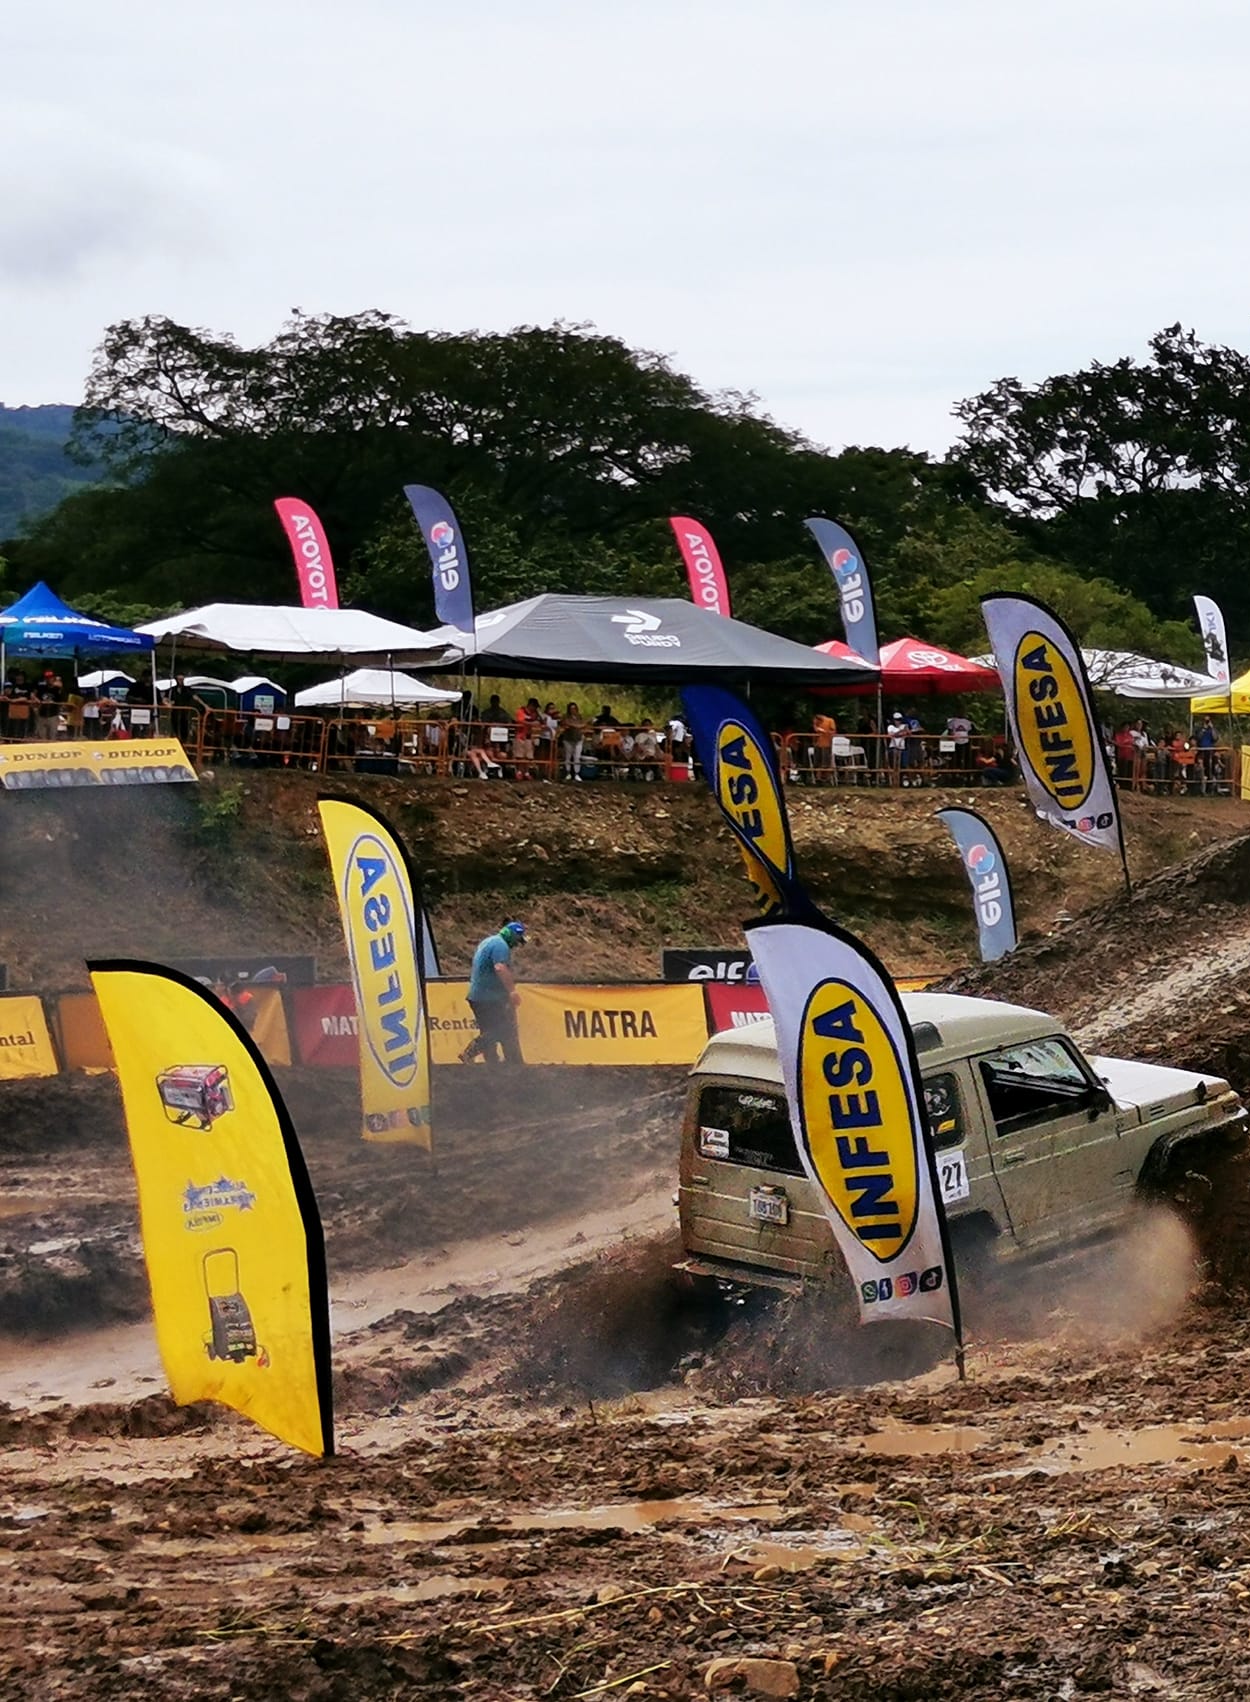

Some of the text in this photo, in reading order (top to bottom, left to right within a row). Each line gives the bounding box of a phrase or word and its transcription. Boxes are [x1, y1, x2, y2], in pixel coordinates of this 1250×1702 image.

[1021, 644, 1084, 797] INFESA
[13, 751, 83, 762] DUNLOP
[108, 749, 177, 759] DUNLOP
[564, 1010, 658, 1038] MATRA
[812, 999, 903, 1241] INFESA
[942, 1162, 963, 1192] 27
